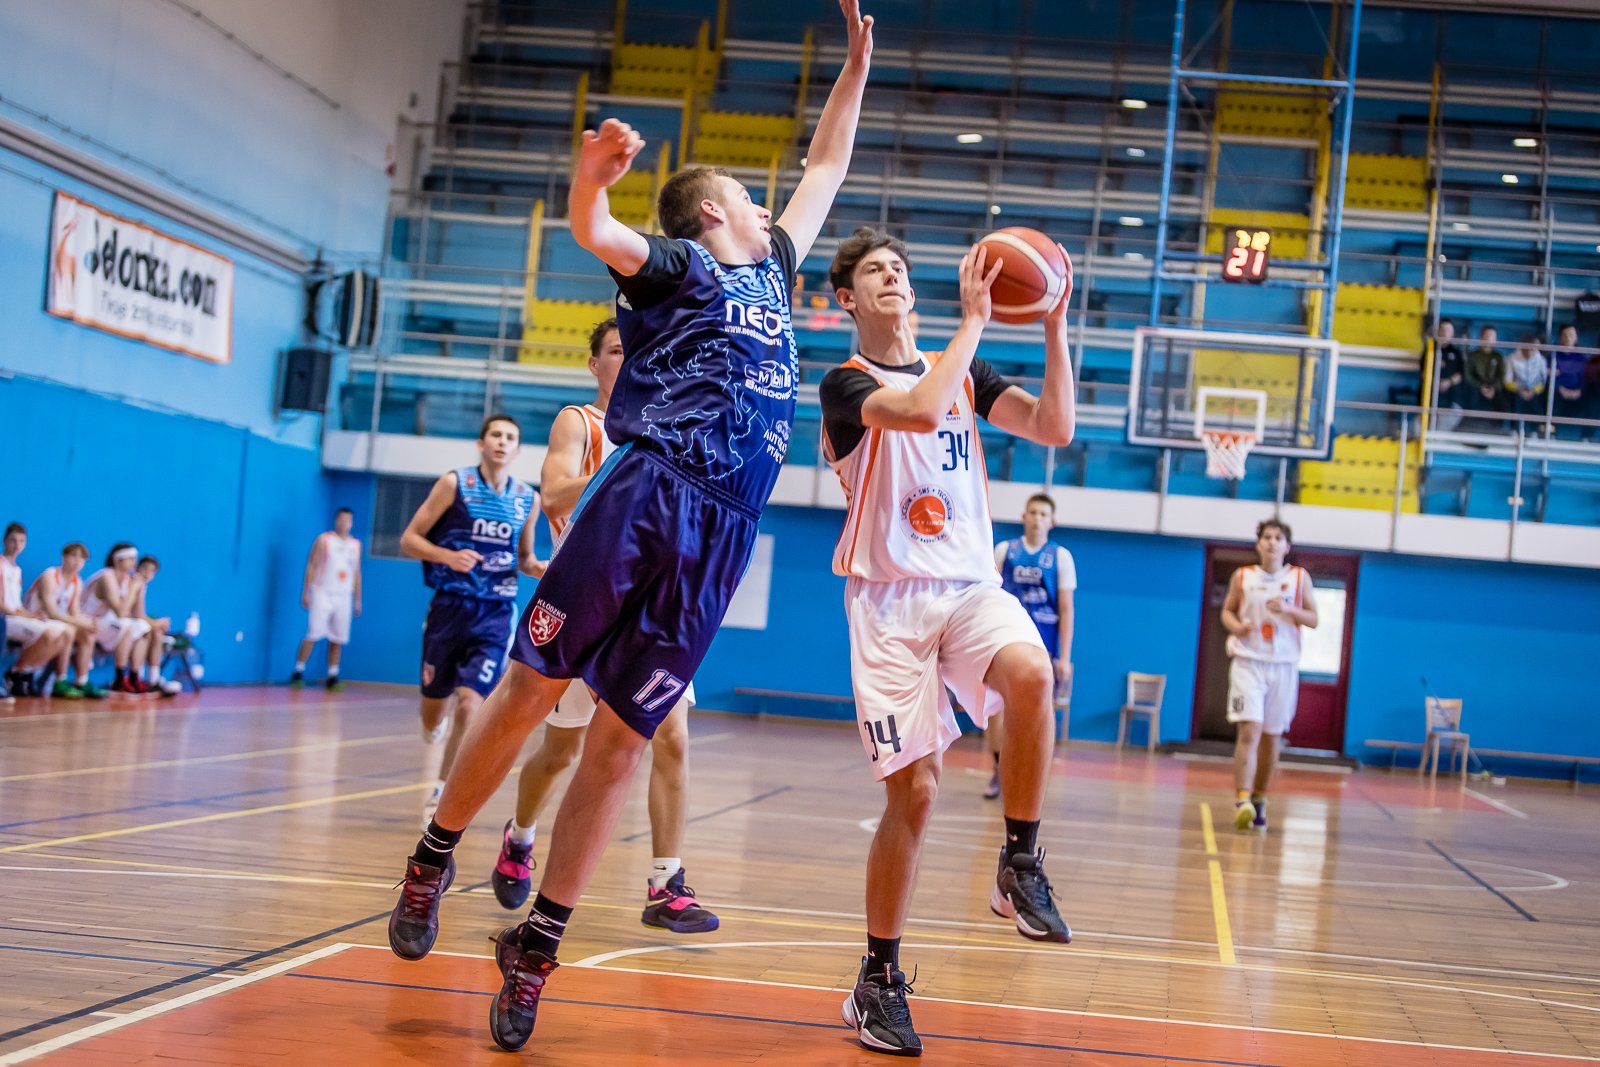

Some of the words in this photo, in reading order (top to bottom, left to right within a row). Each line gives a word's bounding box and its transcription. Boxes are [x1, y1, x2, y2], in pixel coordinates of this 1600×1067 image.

[1226, 248, 1265, 277] 21
[937, 430, 970, 471] 34
[537, 598, 567, 620] KŁODZKO
[478, 659, 497, 683] 5
[632, 668, 686, 712] 17
[864, 714, 902, 762] 34
